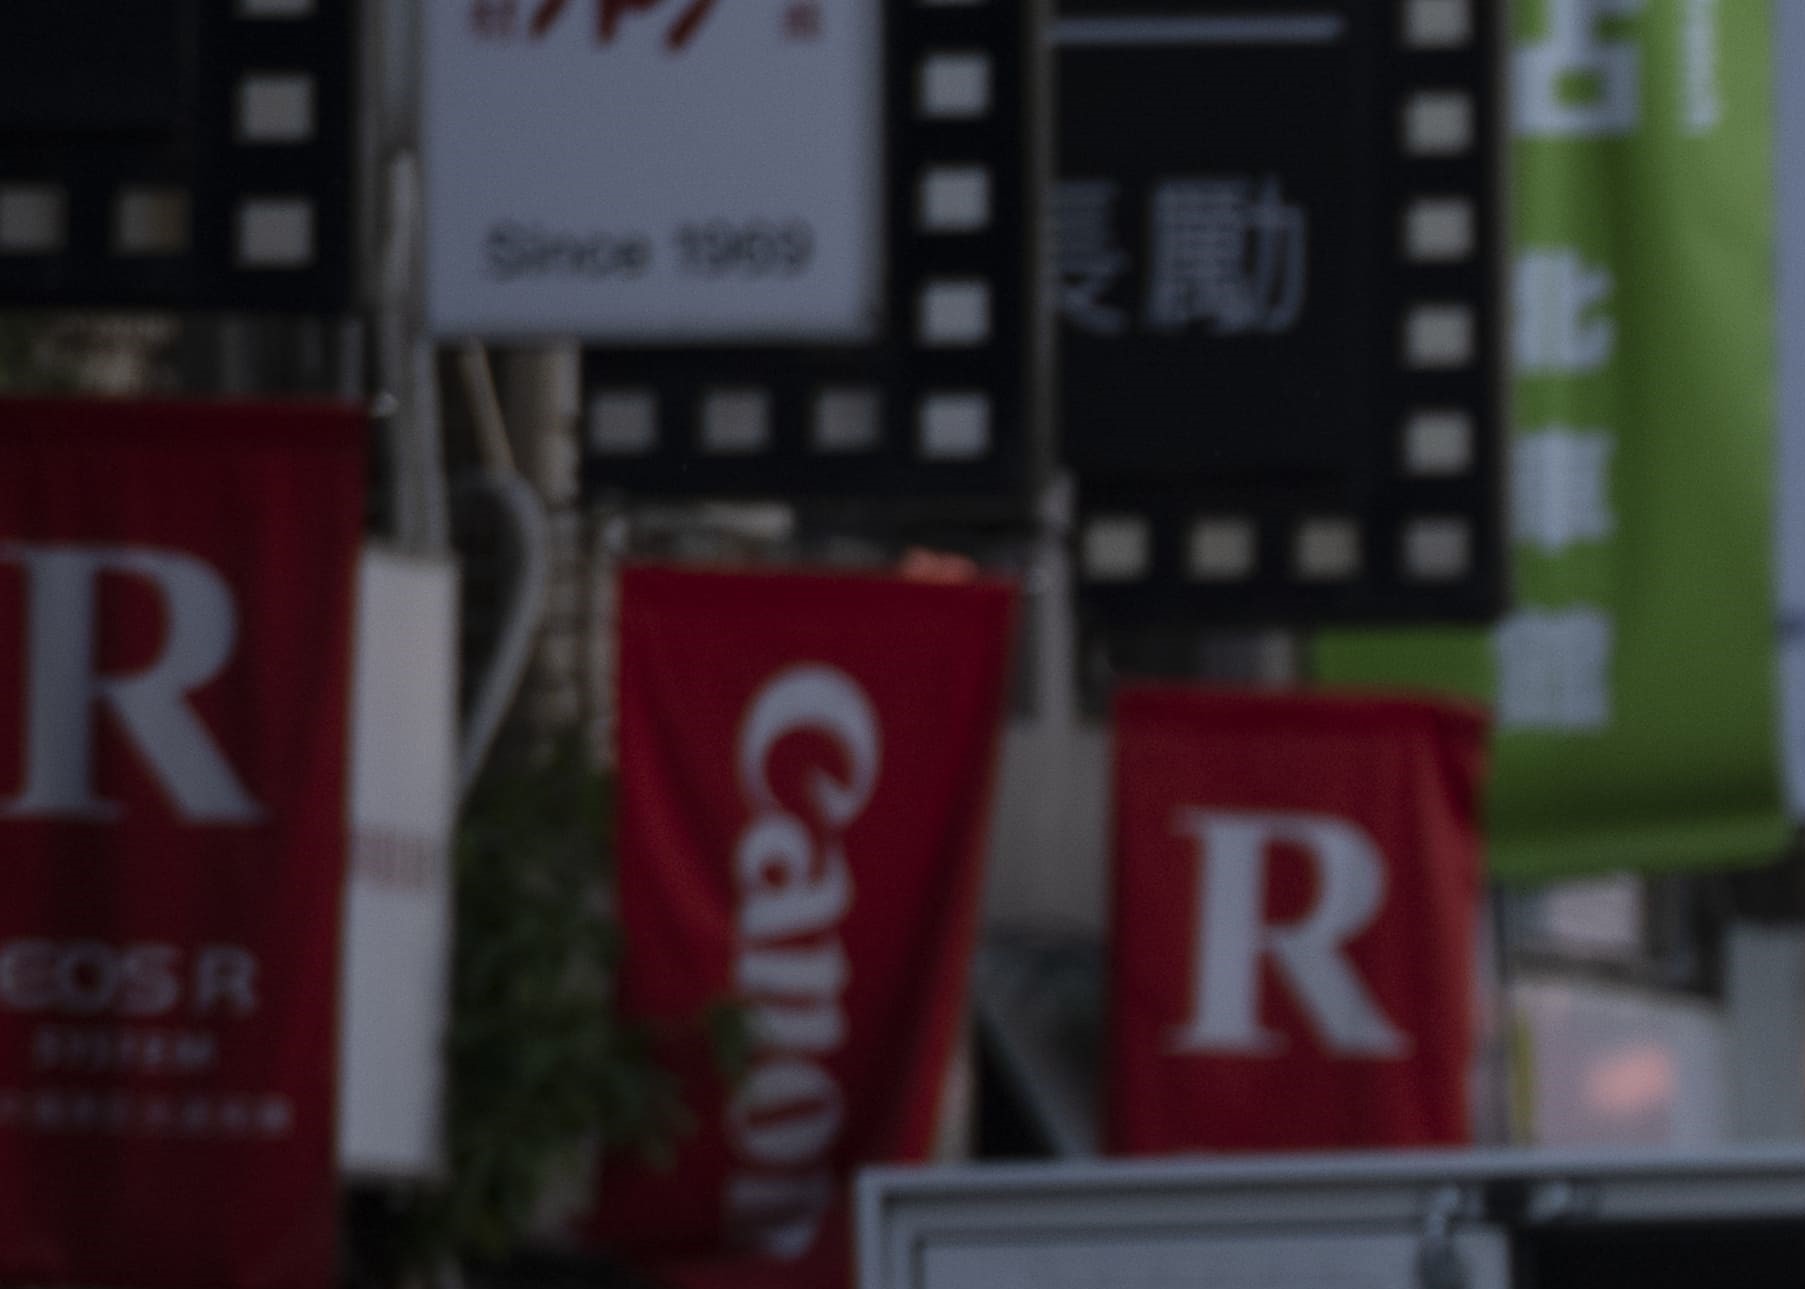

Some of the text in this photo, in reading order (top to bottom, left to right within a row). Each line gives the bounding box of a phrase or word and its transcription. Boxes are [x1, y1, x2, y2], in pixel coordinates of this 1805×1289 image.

[482, 218, 652, 282] Since
[0, 543, 268, 822] R
[724, 662, 882, 1260] Canon
[1168, 806, 1408, 1060] R
